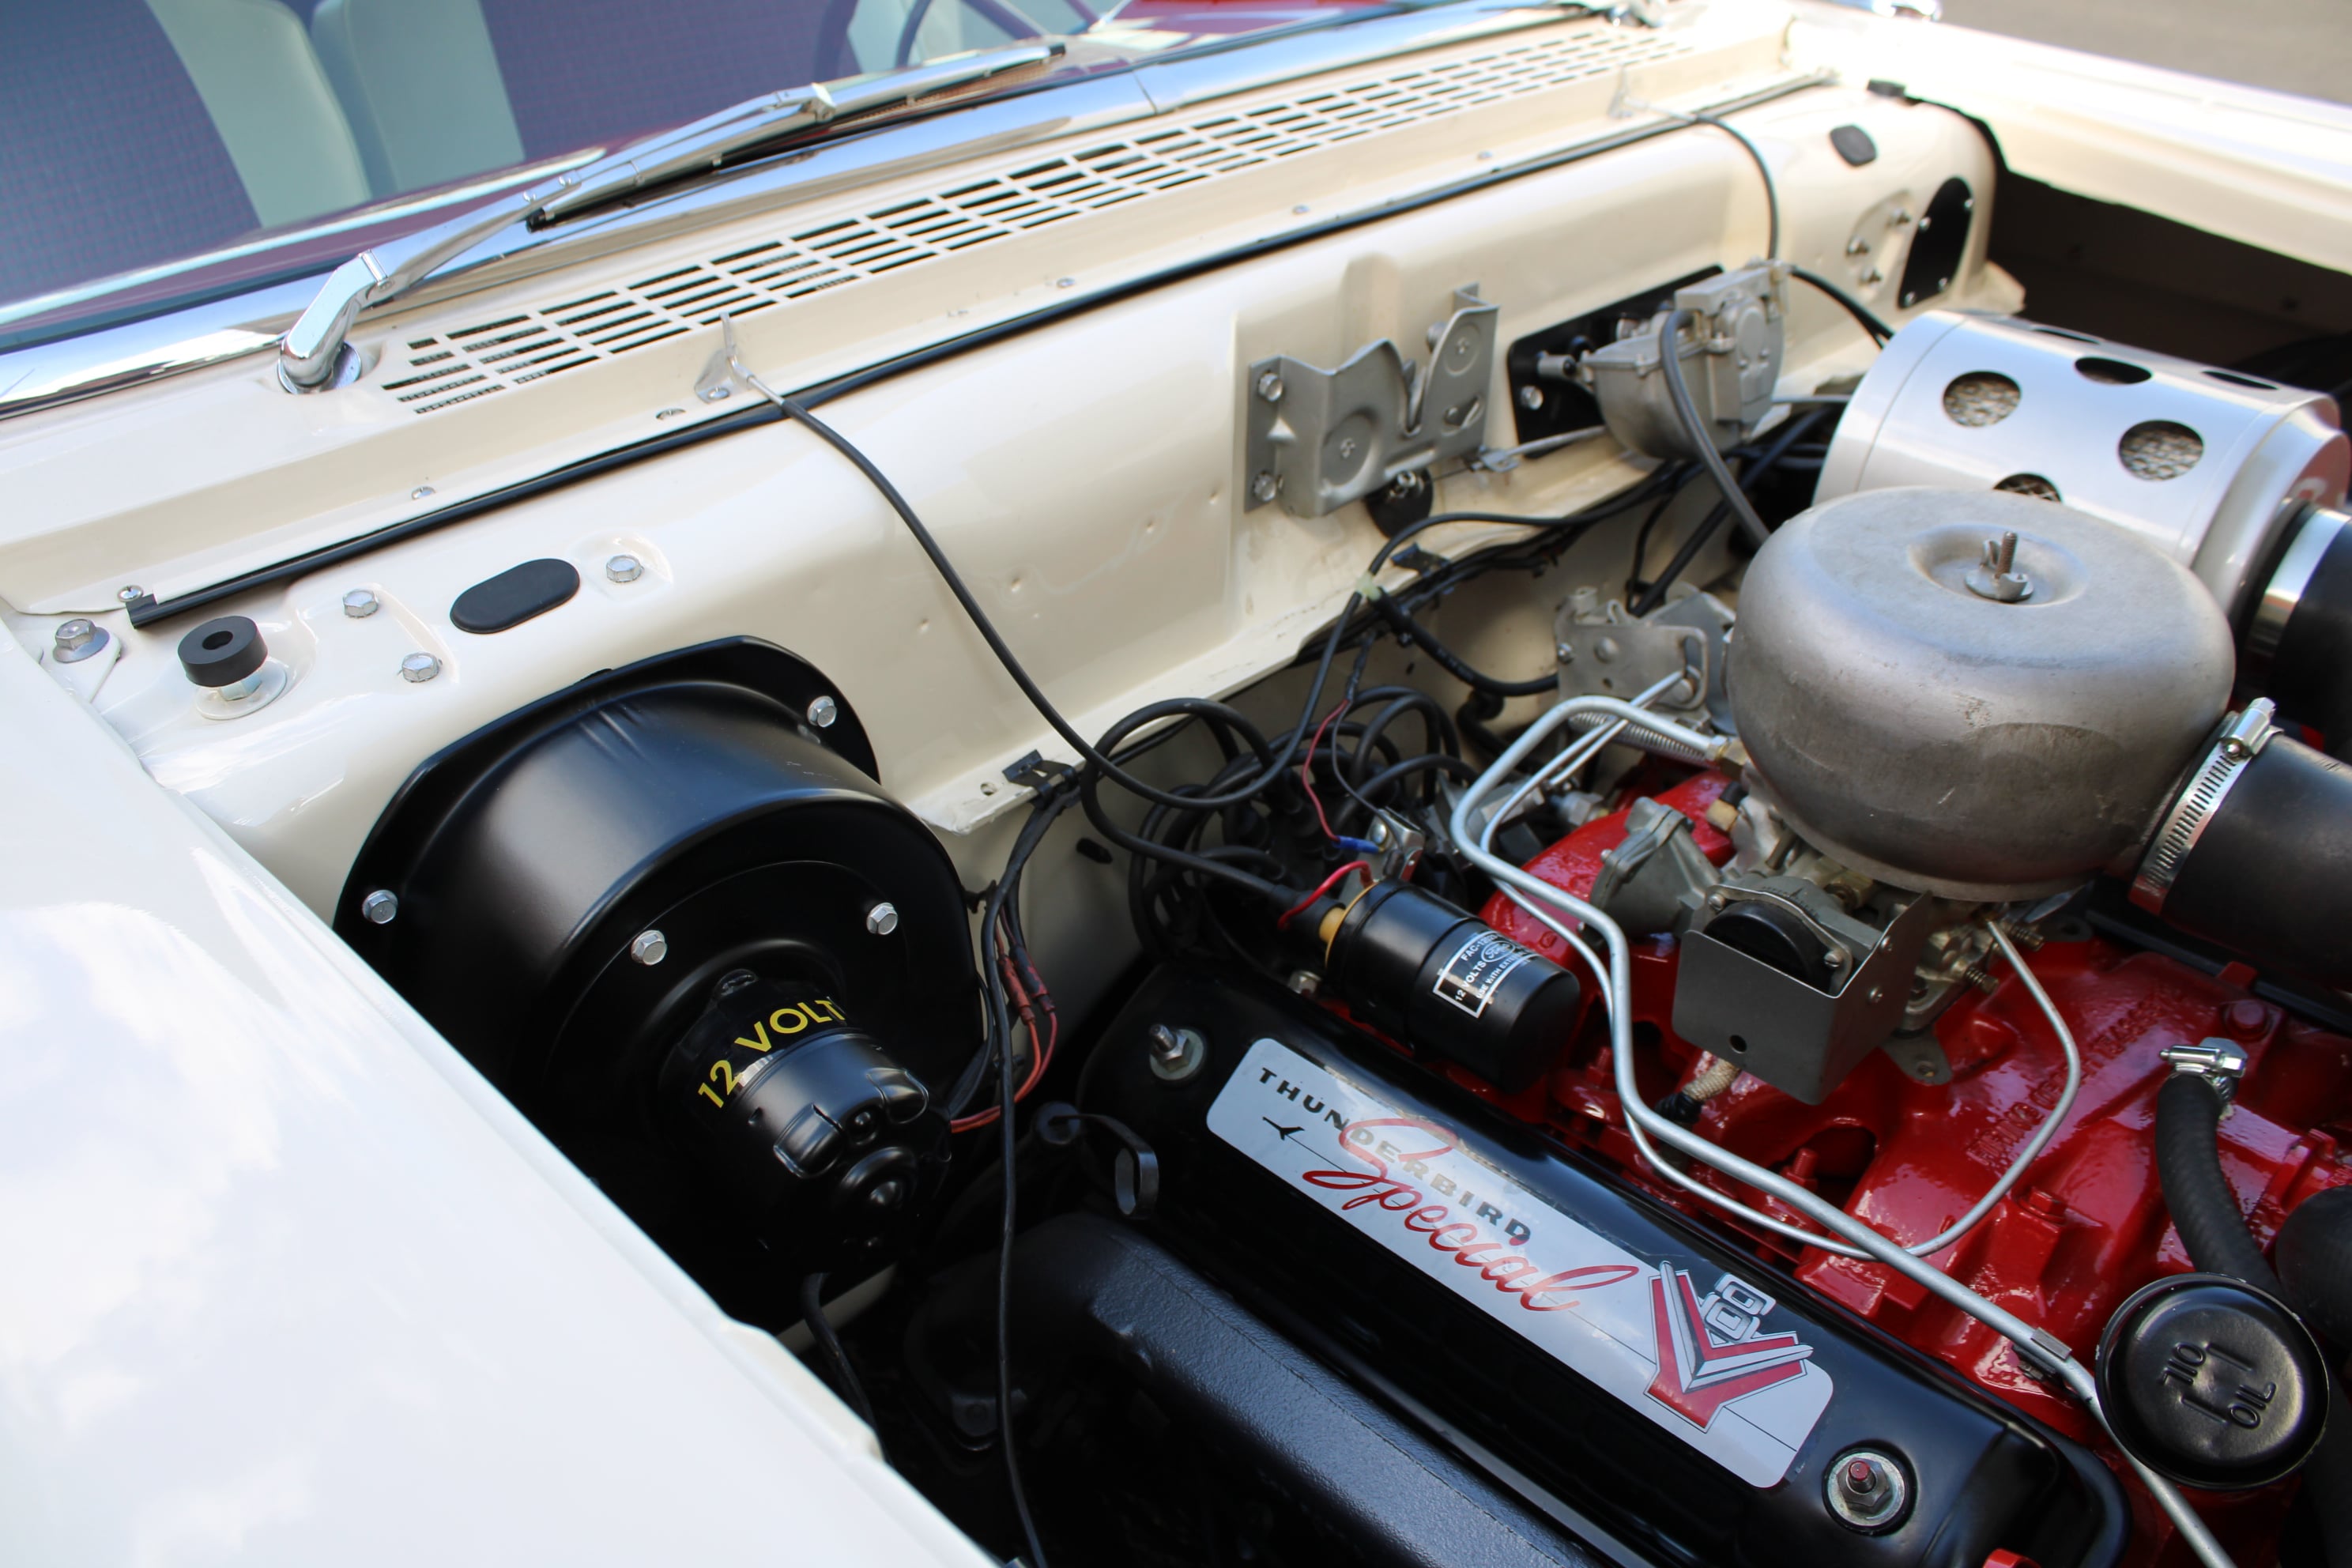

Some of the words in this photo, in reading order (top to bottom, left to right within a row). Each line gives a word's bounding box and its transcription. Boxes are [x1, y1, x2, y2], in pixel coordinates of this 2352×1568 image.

[1455, 989, 1466, 1001] 12
[1461, 960, 1487, 989] VOLTS
[1476, 984, 1489, 998] USE
[1485, 965, 1502, 986] WITH
[697, 1059, 744, 1108] 12
[734, 999, 846, 1053] VOLT
[1257, 1068, 1533, 1241] THUNDERBIRD
[1302, 1118, 1639, 1312] Special
[2160, 1341, 2207, 1385] OIL
[2227, 1381, 2277, 1429] OIL
